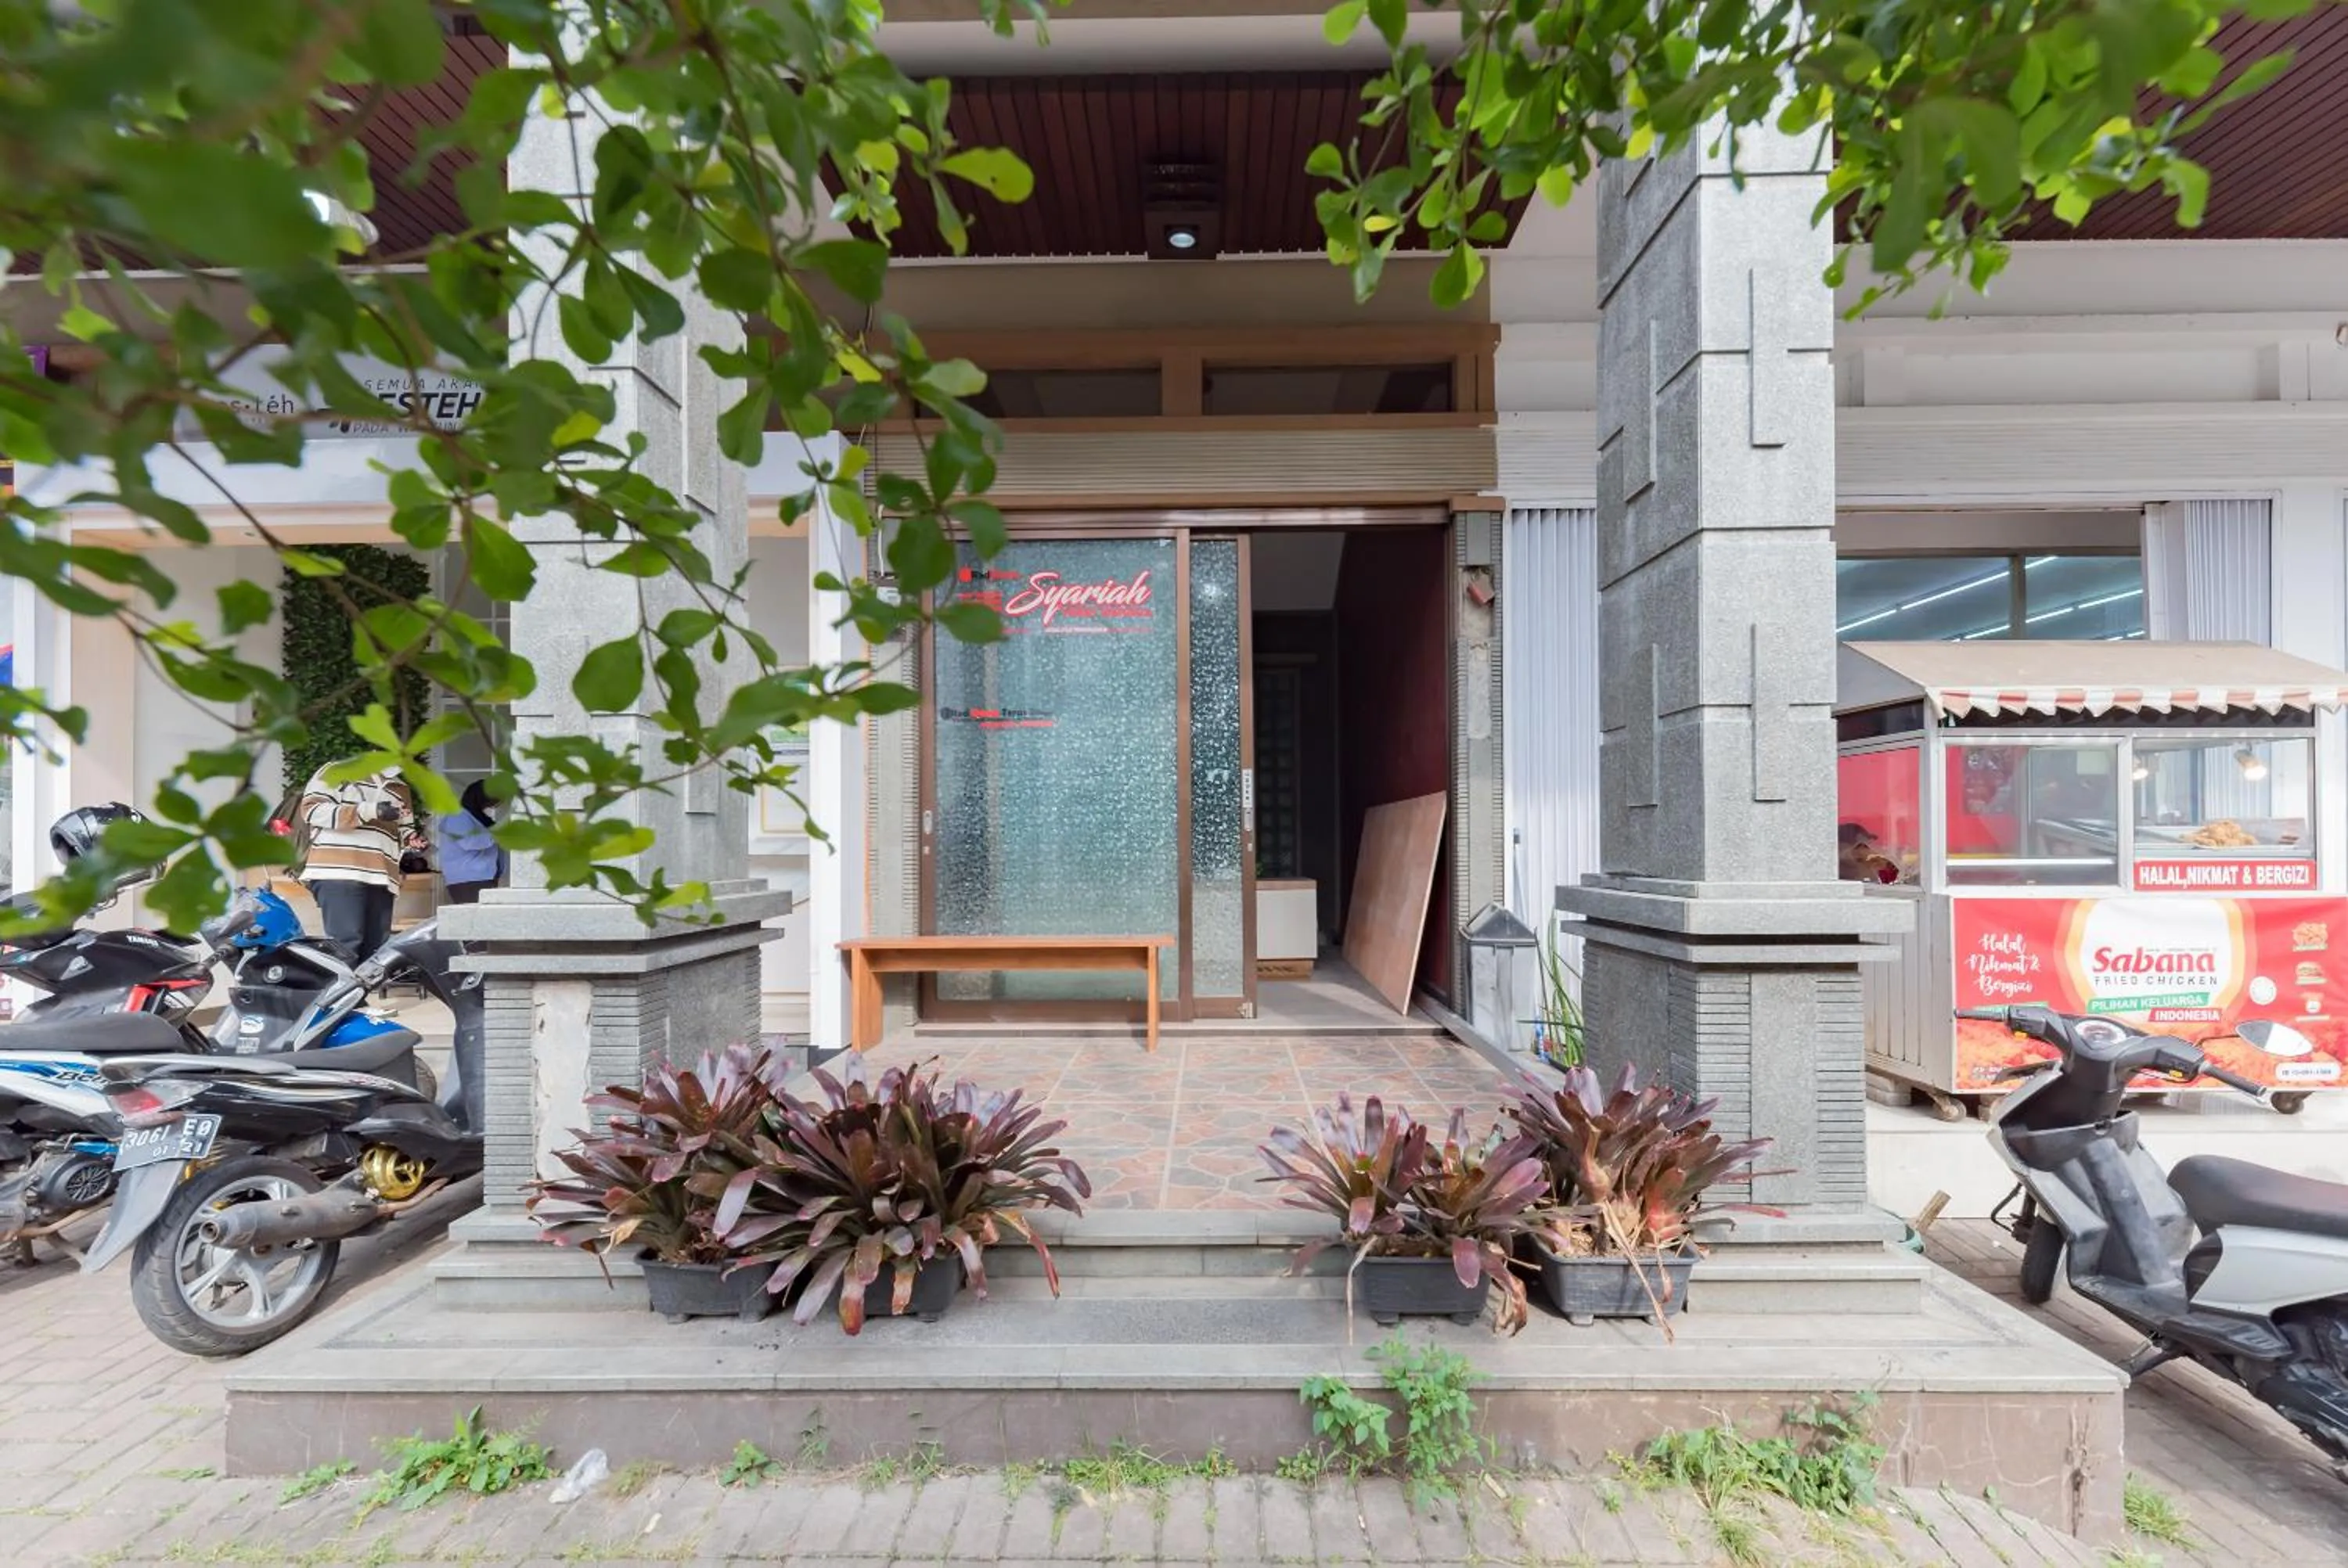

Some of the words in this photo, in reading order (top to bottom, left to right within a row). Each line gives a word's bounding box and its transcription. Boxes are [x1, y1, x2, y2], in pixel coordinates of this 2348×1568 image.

[1005, 569, 1153, 627] Syariah
[2242, 865, 2252, 885] &
[2256, 865, 2310, 885] BERGIZI
[1979, 933, 2026, 955] Halal
[2093, 946, 2216, 973] Sabana
[2094, 976, 2139, 986] FRIED
[2146, 976, 2218, 986] CHICKEN
[2091, 998, 2138, 1011] PILIHAN
[2141, 994, 2204, 1008] KELUARGA
[2155, 1009, 2221, 1022] INDONESIA
